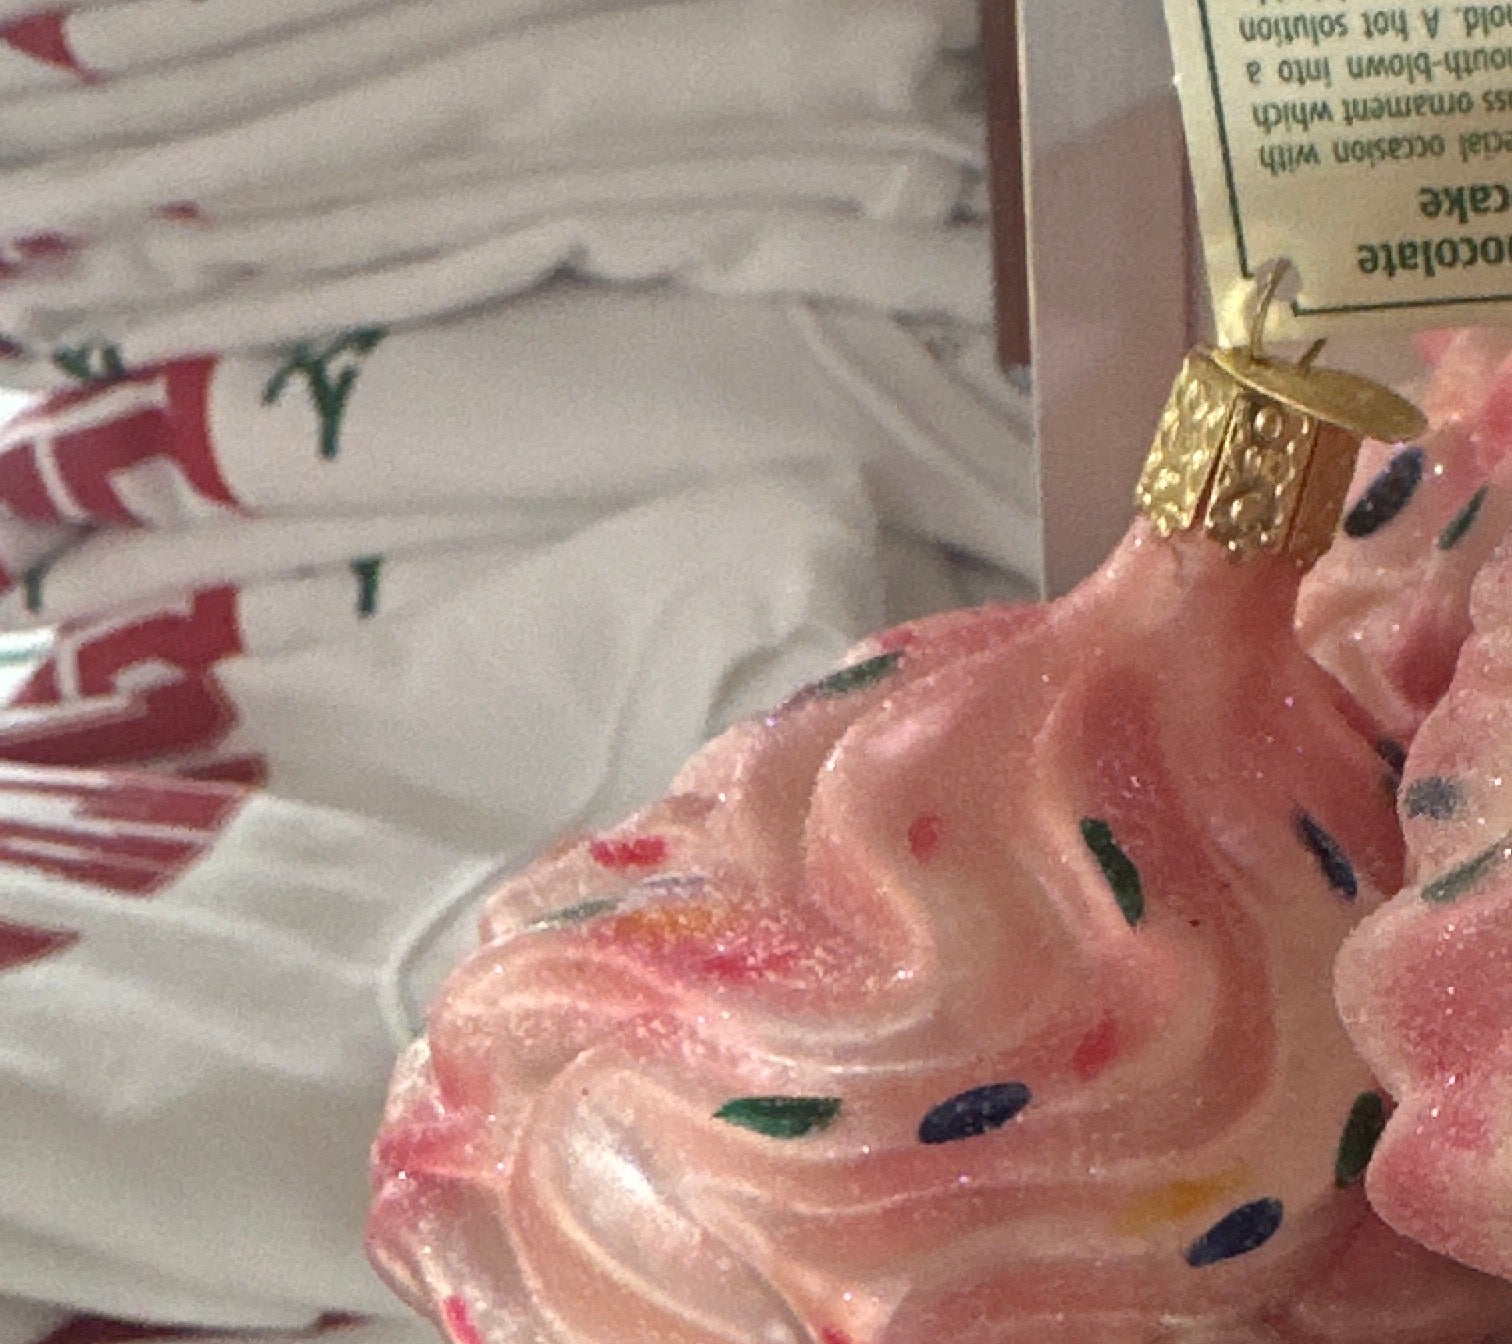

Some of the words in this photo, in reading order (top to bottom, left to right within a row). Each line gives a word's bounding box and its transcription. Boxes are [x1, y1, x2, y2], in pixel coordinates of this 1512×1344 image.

[1238, 12, 1350, 47] solution
[1361, 8, 1409, 43] hot
[1421, 6, 1440, 40] A
[1246, 59, 1263, 84] a
[1277, 56, 1333, 89] into
[1252, 100, 1336, 136] which
[1341, 89, 1475, 127] ornament
[1259, 140, 1323, 177] with
[1331, 133, 1447, 169] occasion
